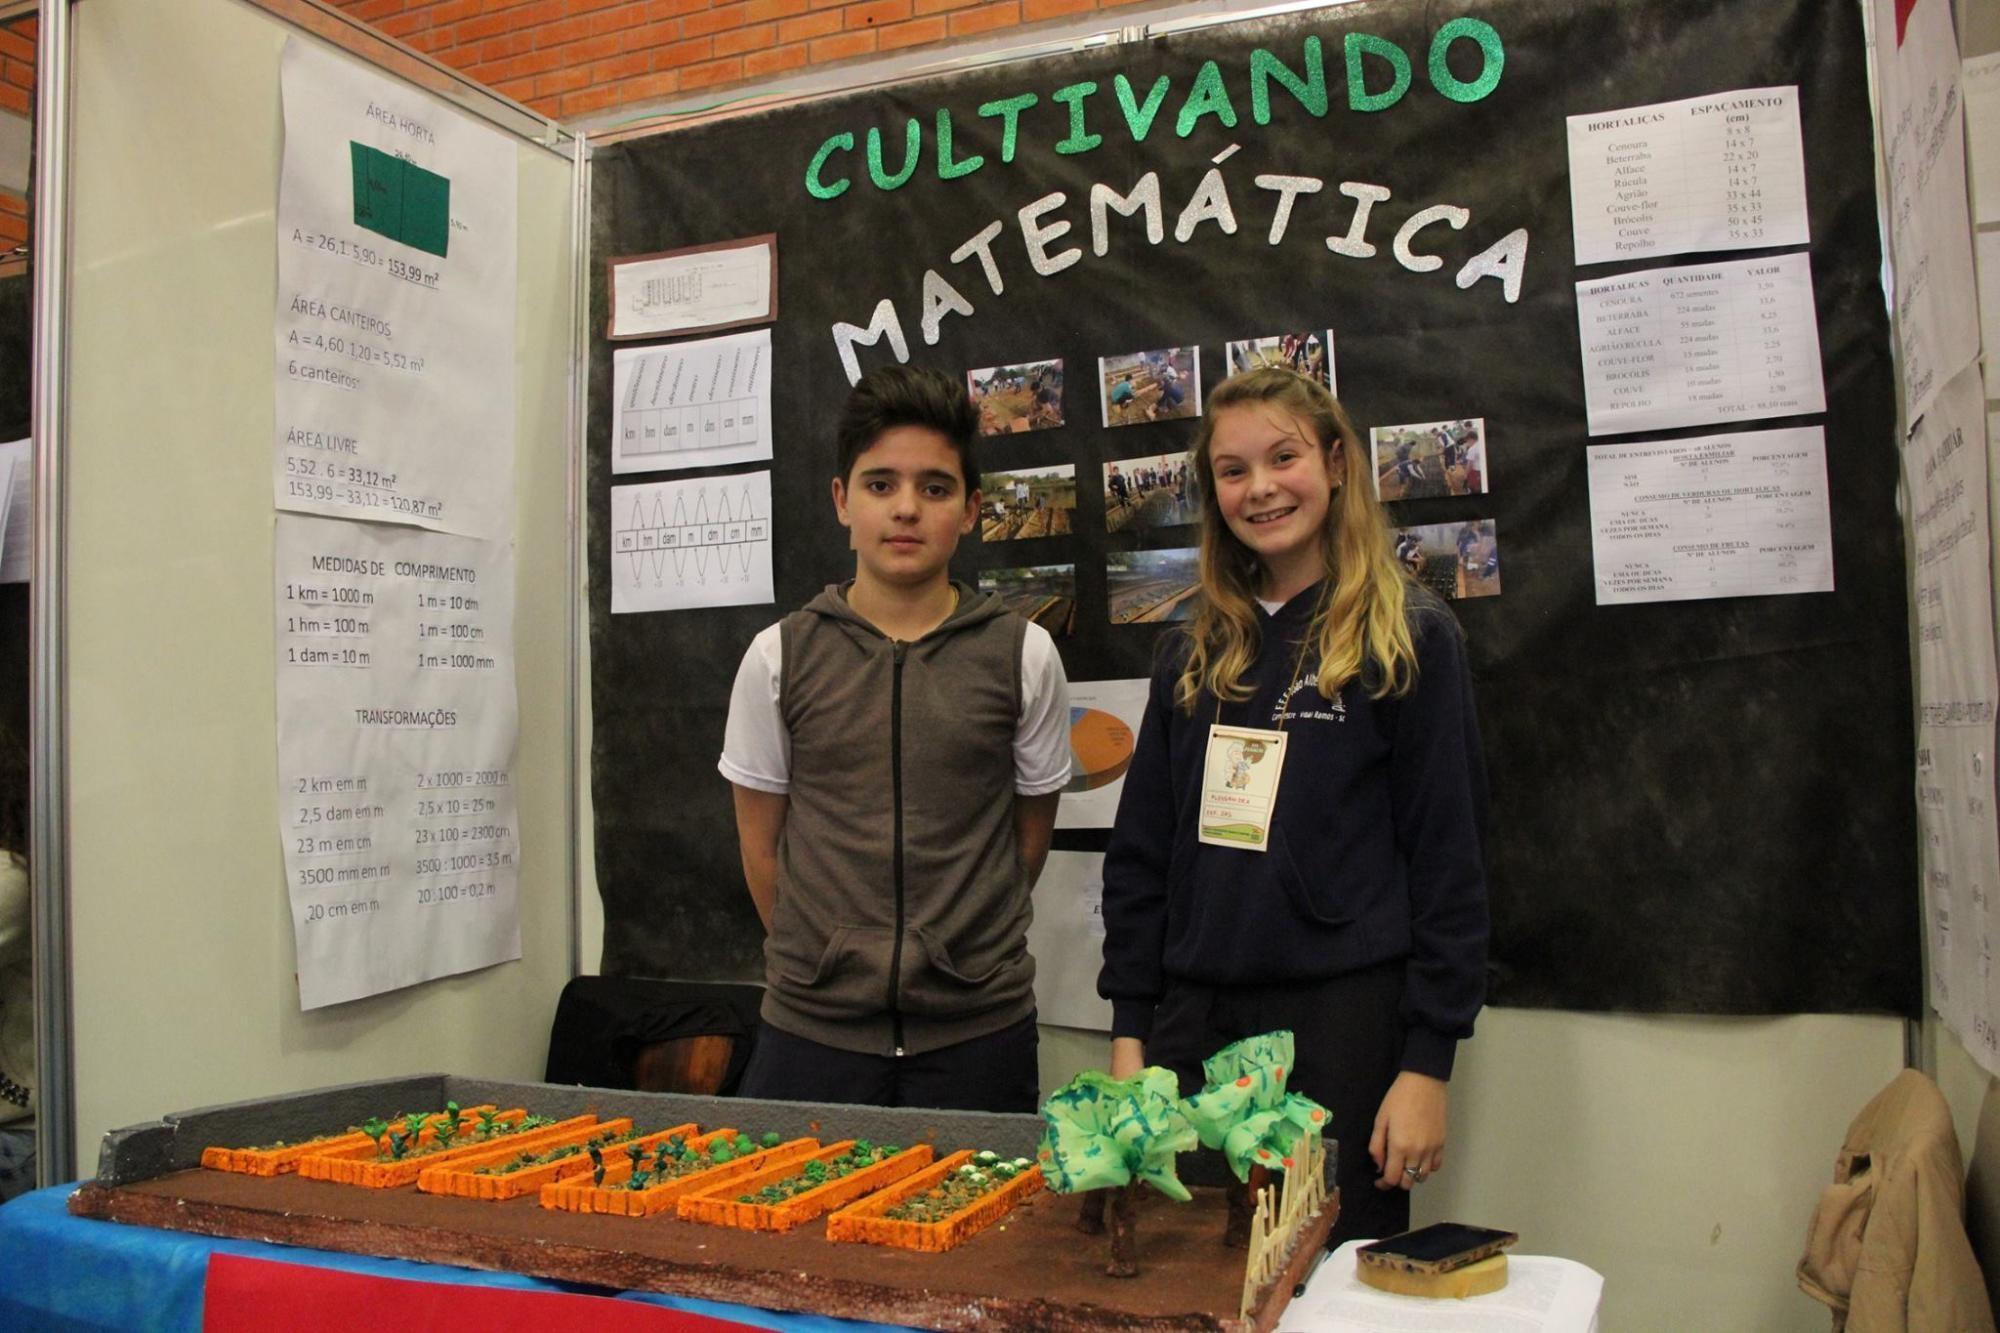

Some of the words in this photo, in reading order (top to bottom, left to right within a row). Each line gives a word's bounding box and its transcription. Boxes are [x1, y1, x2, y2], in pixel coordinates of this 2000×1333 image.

[804, 16, 1505, 199] CULTIVANDO
[366, 102, 397, 127] ÁREA
[400, 119, 435, 145] HORTA
[1726, 114, 1749, 123] (cm)
[1608, 142, 1648, 152] Cenoura
[1749, 137, 1754, 146] 7
[1616, 166, 1645, 175] Alface
[1751, 163, 1756, 171] 7
[1619, 228, 1650, 237] Couve
[1616, 239, 1655, 251] Repolho
[293, 229, 302, 243] A
[353, 245, 376, 265] 5,90
[388, 258, 421, 281] 153,99
[831, 143, 1528, 389] MATEMÁTICA
[291, 295, 326, 319] ÁREA
[330, 307, 391, 336] CANTEIROS
[289, 330, 298, 344] A
[315, 336, 344, 353] 4,60
[384, 351, 406, 369] 5,52
[289, 361, 297, 375] 6
[625, 428, 635, 439] km
[645, 427, 655, 437] hm
[664, 425, 677, 436] dam
[687, 422, 694, 432] m
[705, 419, 714, 432] dm
[288, 427, 323, 447] ÁREA
[328, 437, 358, 454] LIVRE
[288, 457, 316, 475] 5,52
[327, 464, 335, 478] 6
[349, 468, 379, 486] 33,12
[290, 481, 333, 500] 153,99
[348, 490, 379, 507] 33,12
[391, 496, 425, 514] 120,87
[623, 537, 632, 547] km
[644, 533, 653, 544] hm
[663, 531, 676, 544] dam
[708, 530, 718, 541] dm
[312, 556, 367, 574] MEDIDAS
[371, 561, 385, 576] DE
[395, 562, 476, 583] COMPRIMENTO
[287, 585, 294, 599] 1
[299, 586, 318, 601] km
[332, 588, 360, 603] 1000
[363, 592, 373, 604] m
[418, 594, 424, 608] 1
[428, 597, 437, 608] m
[450, 597, 462, 610] 10
[464, 598, 479, 610] dm
[288, 618, 295, 632] 1
[300, 618, 320, 632] hm
[335, 619, 355, 633] 100
[358, 622, 369, 633] m
[419, 624, 425, 636] 1
[428, 625, 438, 637] m
[451, 625, 468, 637] 100
[470, 627, 484, 639] cm
[289, 649, 295, 662] 1
[301, 649, 329, 663] dam
[342, 650, 356, 664] 10
[359, 653, 370, 664] m
[418, 654, 424, 667] 1
[428, 656, 438, 667] m
[451, 655, 474, 668] 1000
[476, 657, 495, 668] mm
[356, 709, 456, 728] TRANSFORMAÇÕES
[299, 778, 306, 793] 2
[312, 778, 332, 792] km
[337, 779, 353, 791] em
[357, 778, 366, 790] m
[417, 774, 424, 787] 2
[436, 772, 463, 786] 1000
[501, 773, 508, 783] m
[300, 808, 322, 824] 2,5
[326, 806, 352, 821] dam
[356, 807, 370, 819] em
[374, 806, 383, 817] m
[448, 800, 460, 813] 10
[473, 799, 484, 812] 25
[486, 800, 495, 810] m
[416, 829, 428, 844] 23
[440, 828, 459, 841] 100
[472, 825, 494, 840] 2300
[496, 827, 510, 837] cm
[297, 838, 314, 853] 23
[319, 840, 332, 852] m
[337, 839, 353, 850] em
[357, 837, 371, 848] cm
[416, 858, 441, 874] 3500
[451, 855, 476, 870] 1000
[502, 854, 512, 864] m
[299, 868, 334, 885] 3500
[338, 870, 359, 881] mm
[362, 868, 377, 878] em
[380, 866, 390, 877] m
[417, 889, 431, 904] 20
[439, 886, 458, 901] 100
[487, 885, 496, 895] m
[328, 904, 347, 917] cm
[352, 902, 368, 914] em
[370, 899, 380, 910] m
